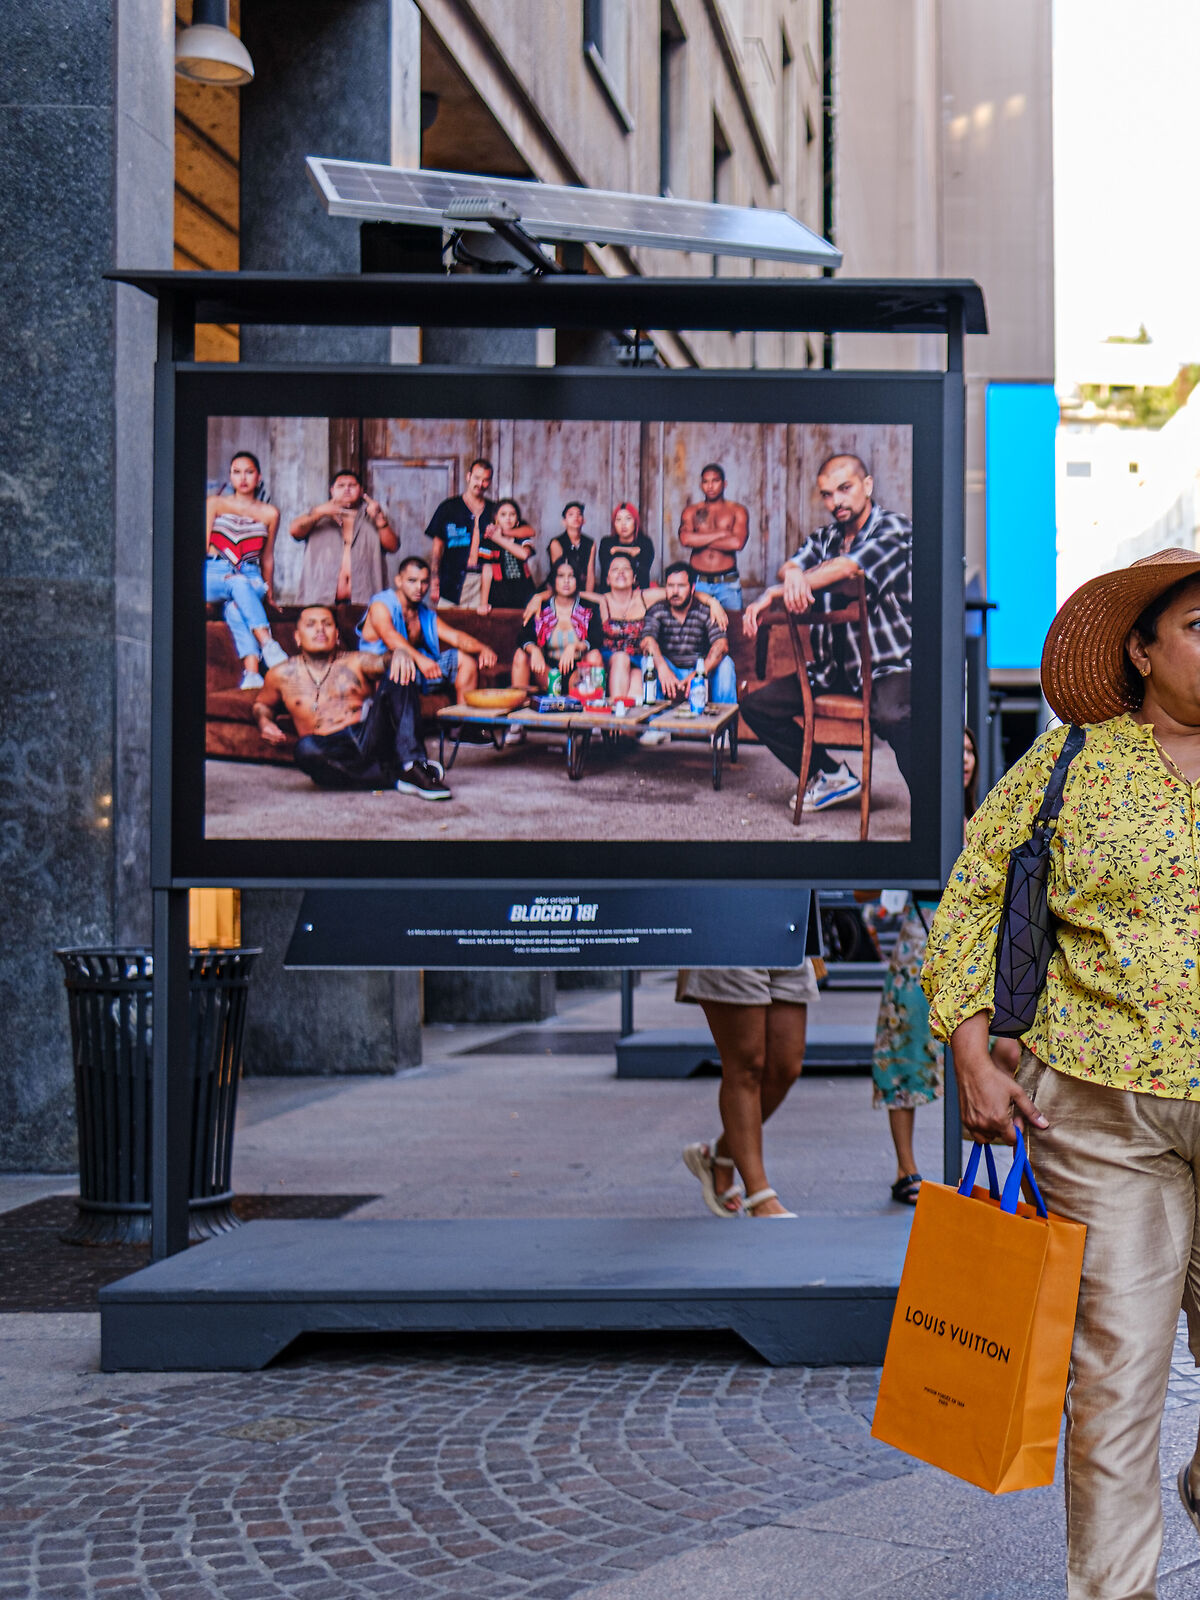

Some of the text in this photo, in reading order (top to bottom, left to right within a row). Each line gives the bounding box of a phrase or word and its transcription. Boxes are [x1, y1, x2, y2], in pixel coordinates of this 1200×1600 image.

[511, 904, 573, 922] BLOCCO
[905, 1306, 1011, 1364] LOUIS VUITTON
